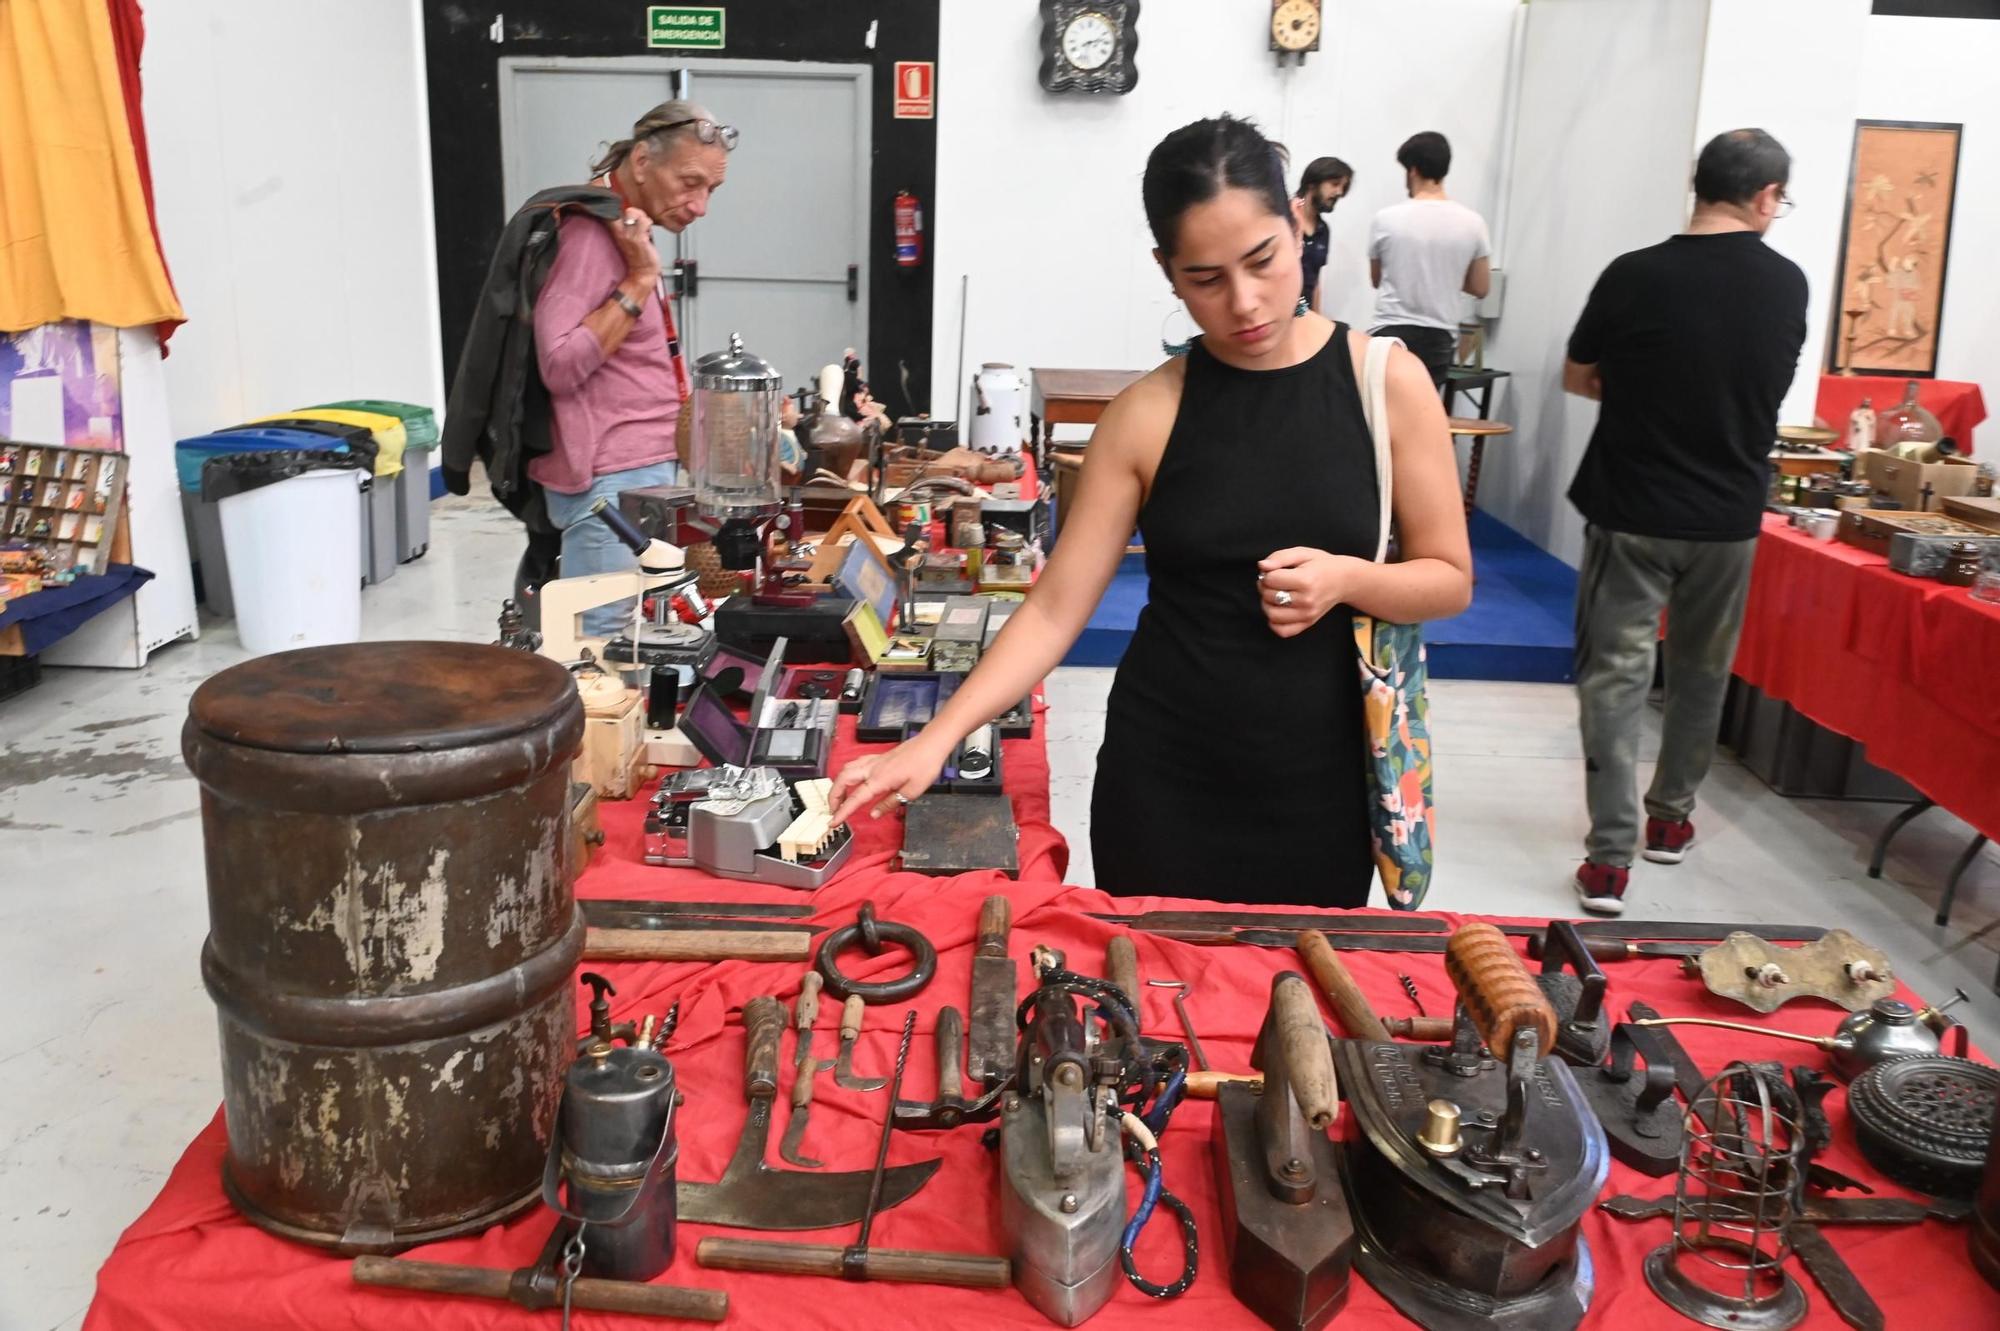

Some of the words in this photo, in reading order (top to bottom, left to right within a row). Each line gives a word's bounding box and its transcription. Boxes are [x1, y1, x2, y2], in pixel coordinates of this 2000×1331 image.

[658, 14, 697, 25] SALIDA
[698, 15, 714, 26] DE
[653, 29, 720, 40] EMERGENCIA
